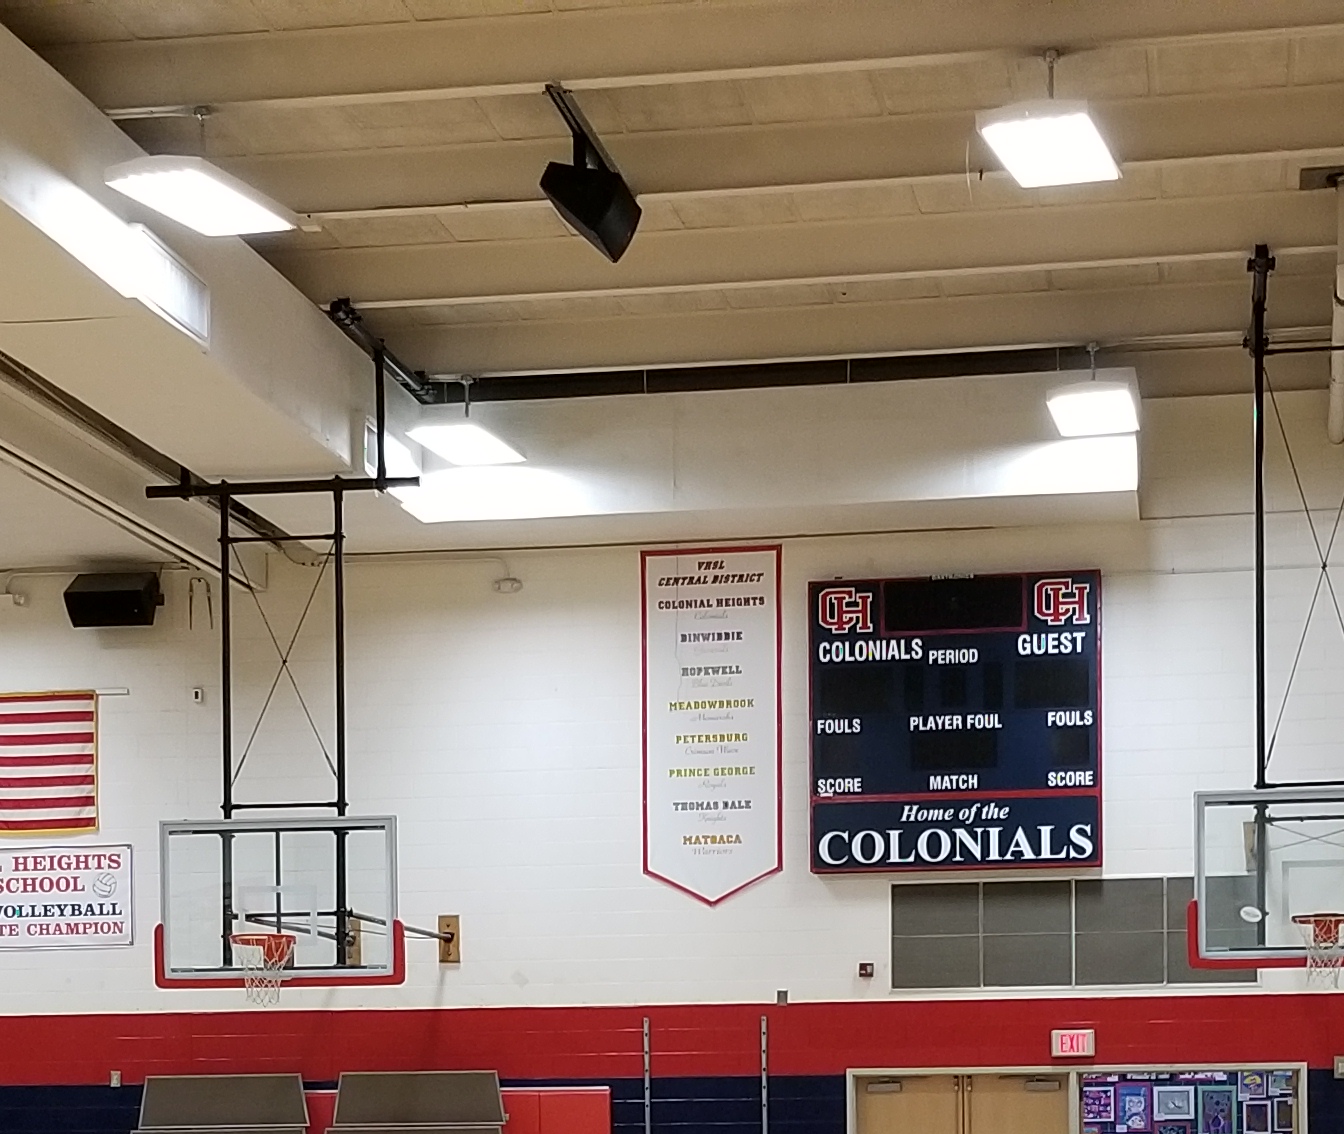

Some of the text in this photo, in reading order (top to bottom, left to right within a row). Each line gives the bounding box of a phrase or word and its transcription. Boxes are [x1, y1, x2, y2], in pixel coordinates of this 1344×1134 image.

[697, 560, 725, 570] VHSL
[658, 573, 764, 587] CENTRAL DISTRICT
[658, 597, 764, 609] COLONIAL HEIGHTS
[680, 632, 743, 642] DINWIDDIE
[1018, 632, 1086, 656] GUEST
[818, 638, 923, 663] COLONIALS
[929, 648, 978, 665] PERIOD
[682, 665, 742, 676] HOPEWELL
[669, 699, 754, 711] MEADOWBROOK
[909, 714, 1003, 732] PLAYER FOUL
[1047, 710, 1093, 727] FOULS
[817, 718, 861, 735] FOULS
[676, 733, 748, 744] PETERSBURG
[669, 766, 755, 778] PRINCE GEORGE
[1047, 771, 1094, 787] SCORE
[817, 778, 862, 793] SCORE
[929, 775, 978, 790] MATCH
[673, 800, 752, 811] THOMAS DALE
[900, 803, 1010, 824] Home of the
[683, 834, 742, 845] MATOACA
[818, 823, 1094, 865] COLONIALS
[12, 853, 122, 872] HEIGHTS
[27, 921, 124, 935] CHAMPION
[1061, 1034, 1087, 1052] EXIT
